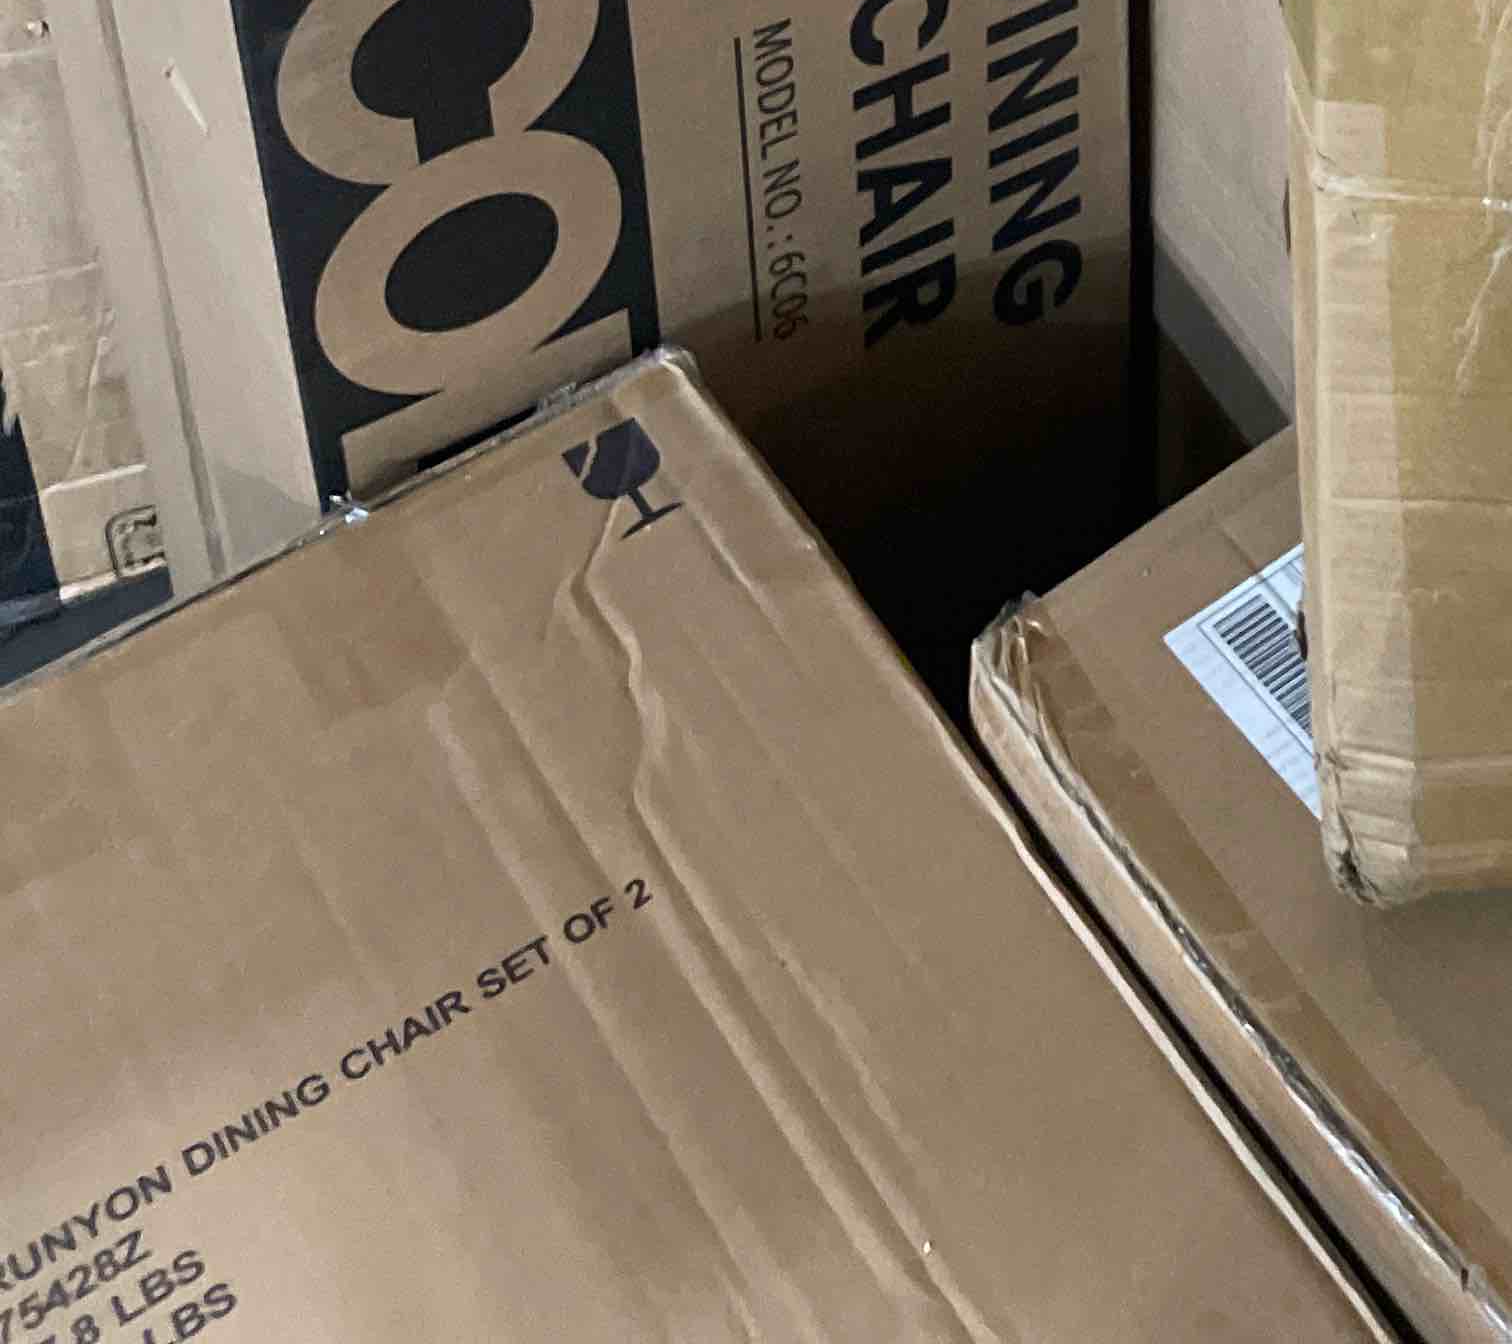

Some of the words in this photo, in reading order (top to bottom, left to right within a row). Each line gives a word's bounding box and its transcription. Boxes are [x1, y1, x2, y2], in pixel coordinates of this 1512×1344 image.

[753, 17, 799, 161] MODEL
[181, 1074, 331, 1176] DINING
[340, 990, 472, 1081] CHAIR
[476, 936, 555, 999] SET
[562, 896, 614, 945] OF
[623, 878, 653, 910] 2
[111, 1250, 205, 1327] LBS
